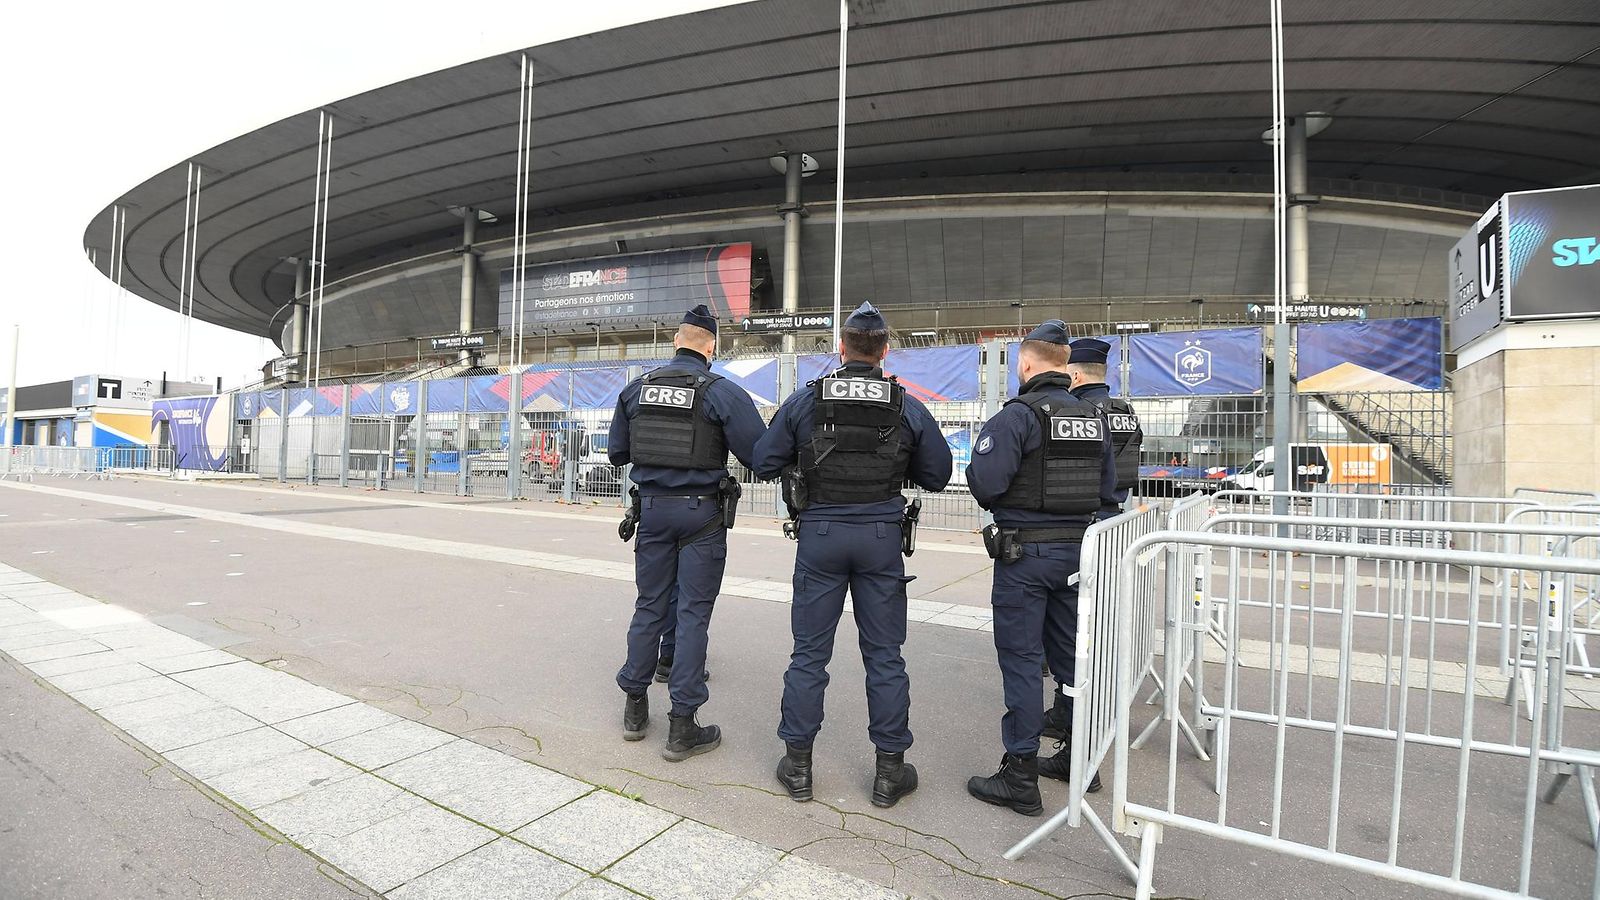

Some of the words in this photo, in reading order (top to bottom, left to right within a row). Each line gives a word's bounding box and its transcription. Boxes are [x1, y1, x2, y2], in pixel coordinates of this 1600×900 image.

[1480, 234, 1496, 299] U
[534, 297, 578, 308] Partageons
[579, 295, 594, 304] nos
[595, 291, 634, 303] émotions
[1320, 305, 1330, 318] U
[794, 316, 802, 328] U
[102, 382, 118, 399] T
[645, 387, 687, 405] CRS
[830, 381, 883, 399] CRS
[1057, 420, 1098, 438] CRS
[1112, 416, 1137, 431] CRS
